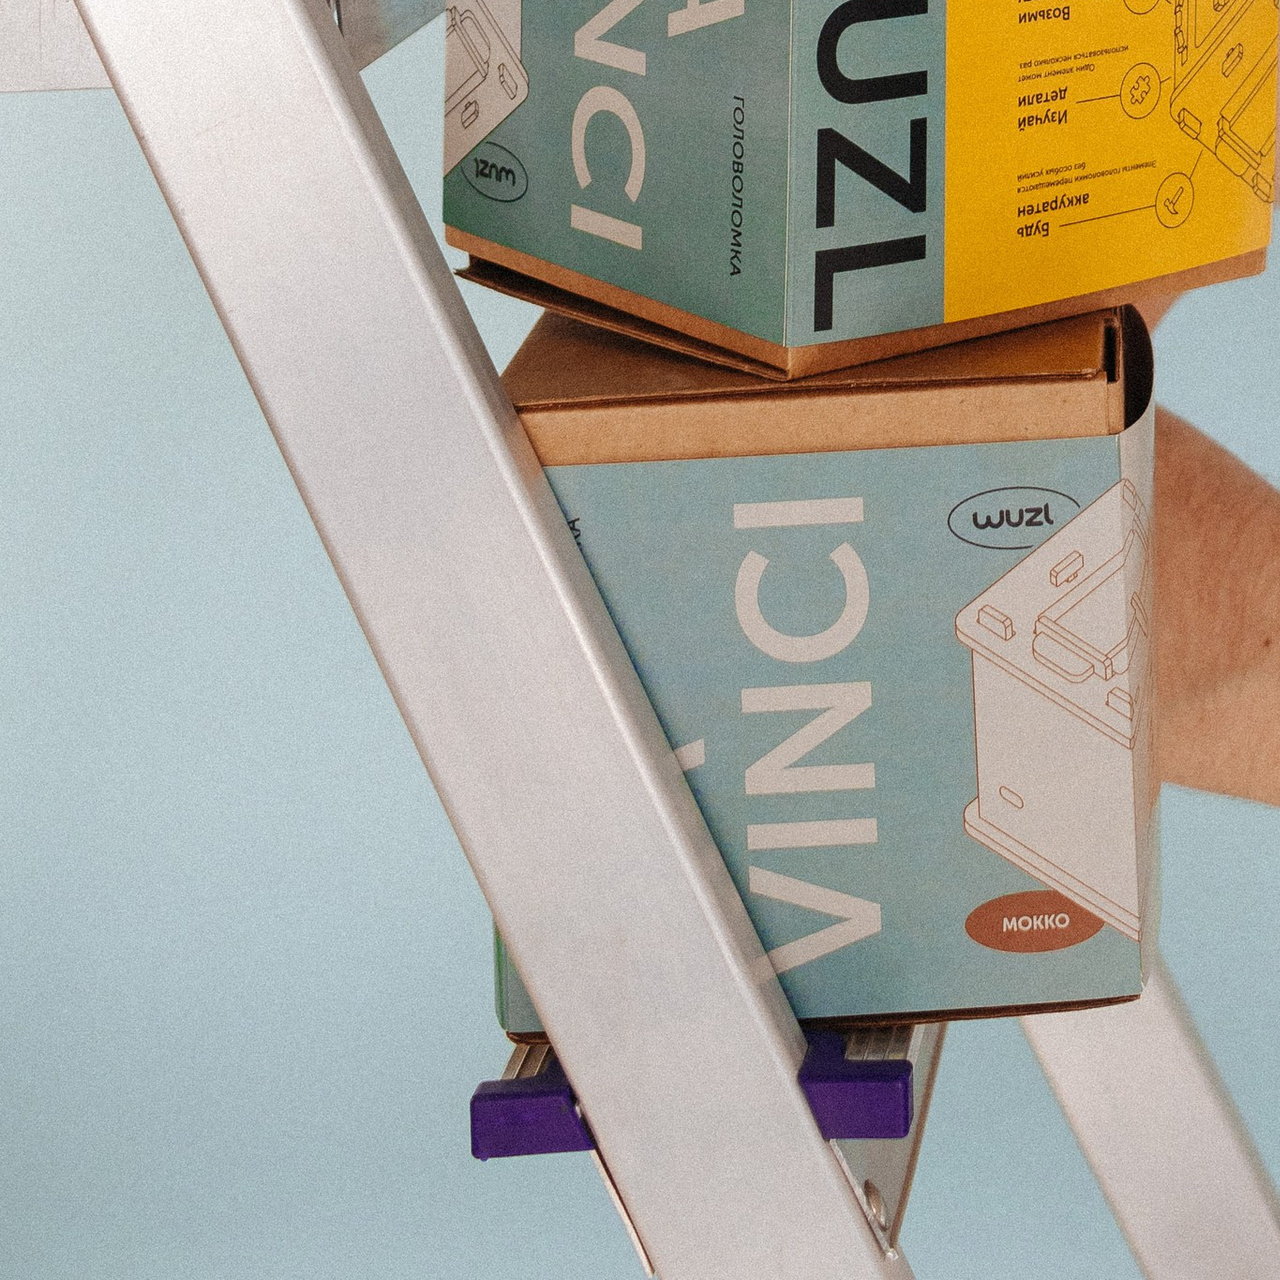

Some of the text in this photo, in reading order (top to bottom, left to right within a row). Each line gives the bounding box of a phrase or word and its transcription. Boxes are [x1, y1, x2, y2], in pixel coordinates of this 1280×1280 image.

[1018, 6, 1070, 24] Возьми
[1020, 45, 1129, 69] использоваться несколько раз
[1018, 64, 1095, 83] Один элемент может
[1018, 86, 1068, 107] детали
[1018, 109, 1067, 131] Изучай
[1017, 162, 1085, 182] без особых усилий
[1074, 168, 1120, 181] головоломки
[1122, 160, 1156, 172] Элементы
[729, 95, 746, 278] ГОЛОВОЛОМКА
[1017, 193, 1089, 217] аккуратен
[1017, 220, 1049, 238] Будь
[972, 502, 1055, 532] wuzl
[733, 495, 882, 977] VINCI
[1001, 910, 1071, 934] МОККО
